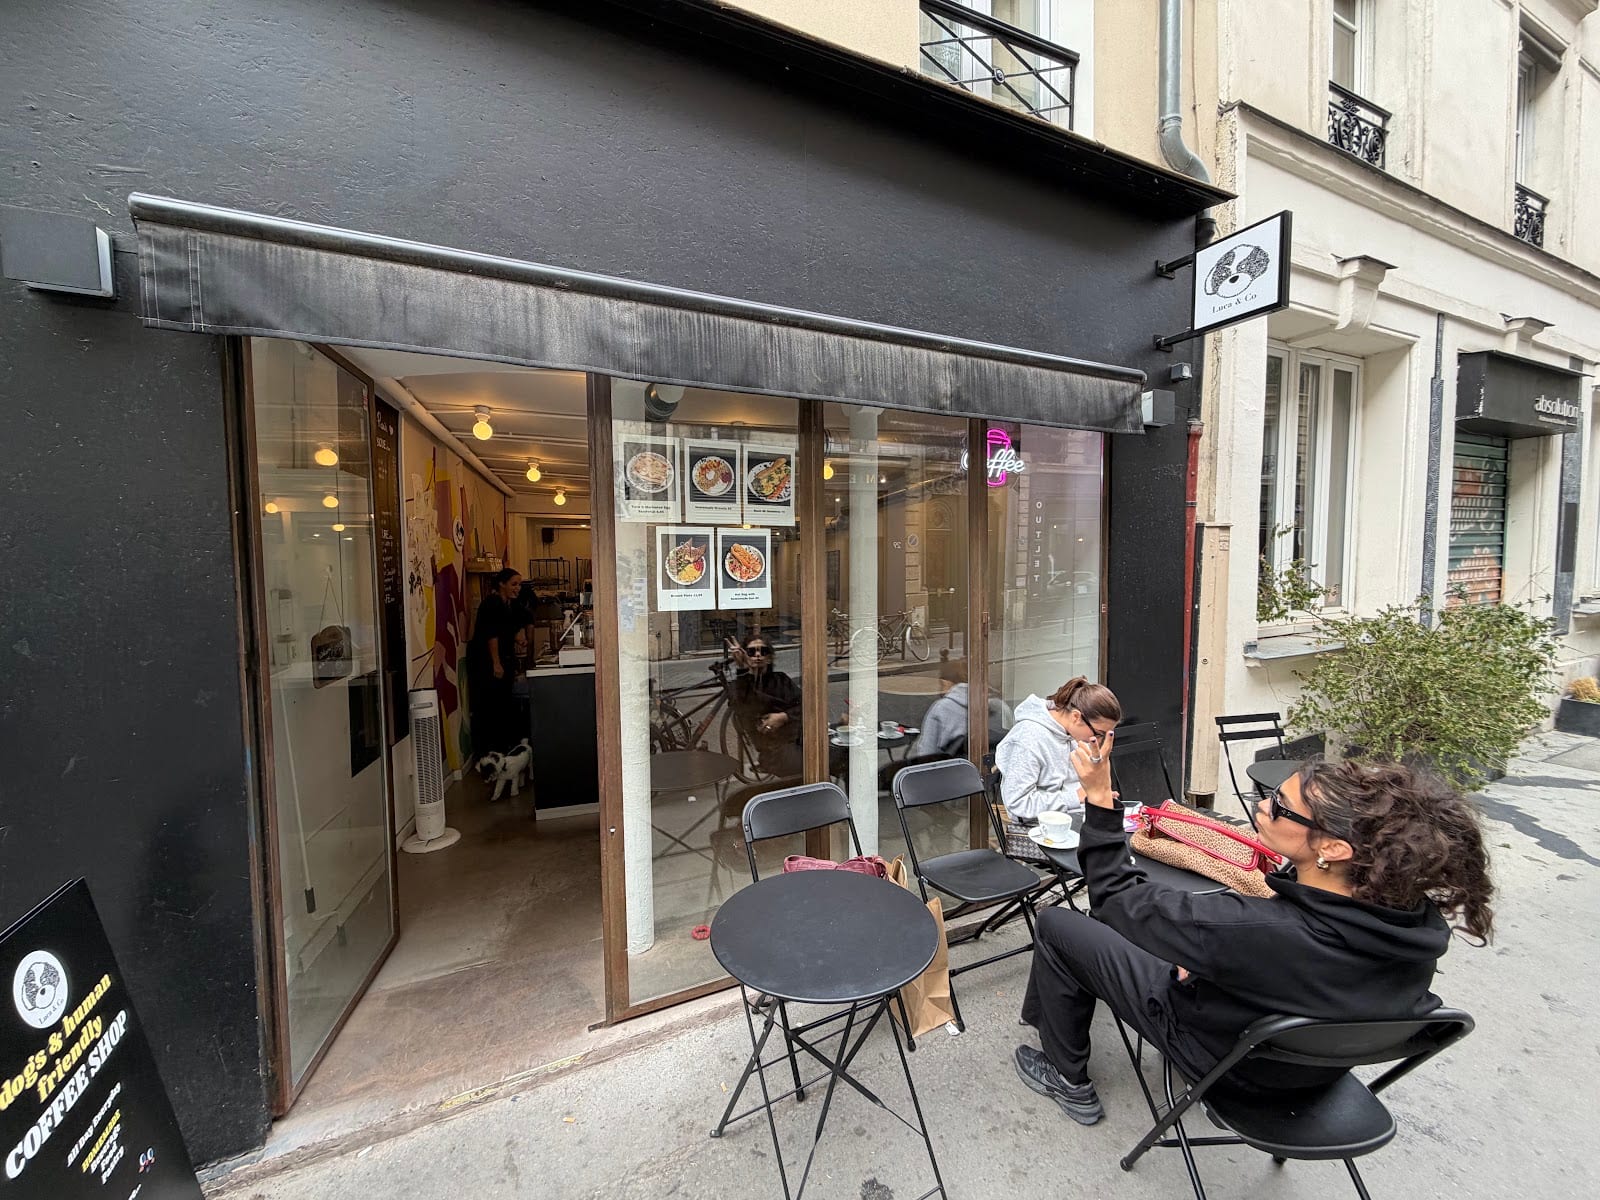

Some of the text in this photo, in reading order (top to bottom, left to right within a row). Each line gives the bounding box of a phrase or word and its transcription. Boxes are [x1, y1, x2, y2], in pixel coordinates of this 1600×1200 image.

[1212, 302, 1233, 313] Luca
[1244, 292, 1257, 302] Co
[1534, 394, 1579, 418] absolution
[0, 973, 112, 1111] dogs & human
[37, 1015, 103, 1103] friendly
[5, 1009, 128, 1179] COFFEE SHOP
